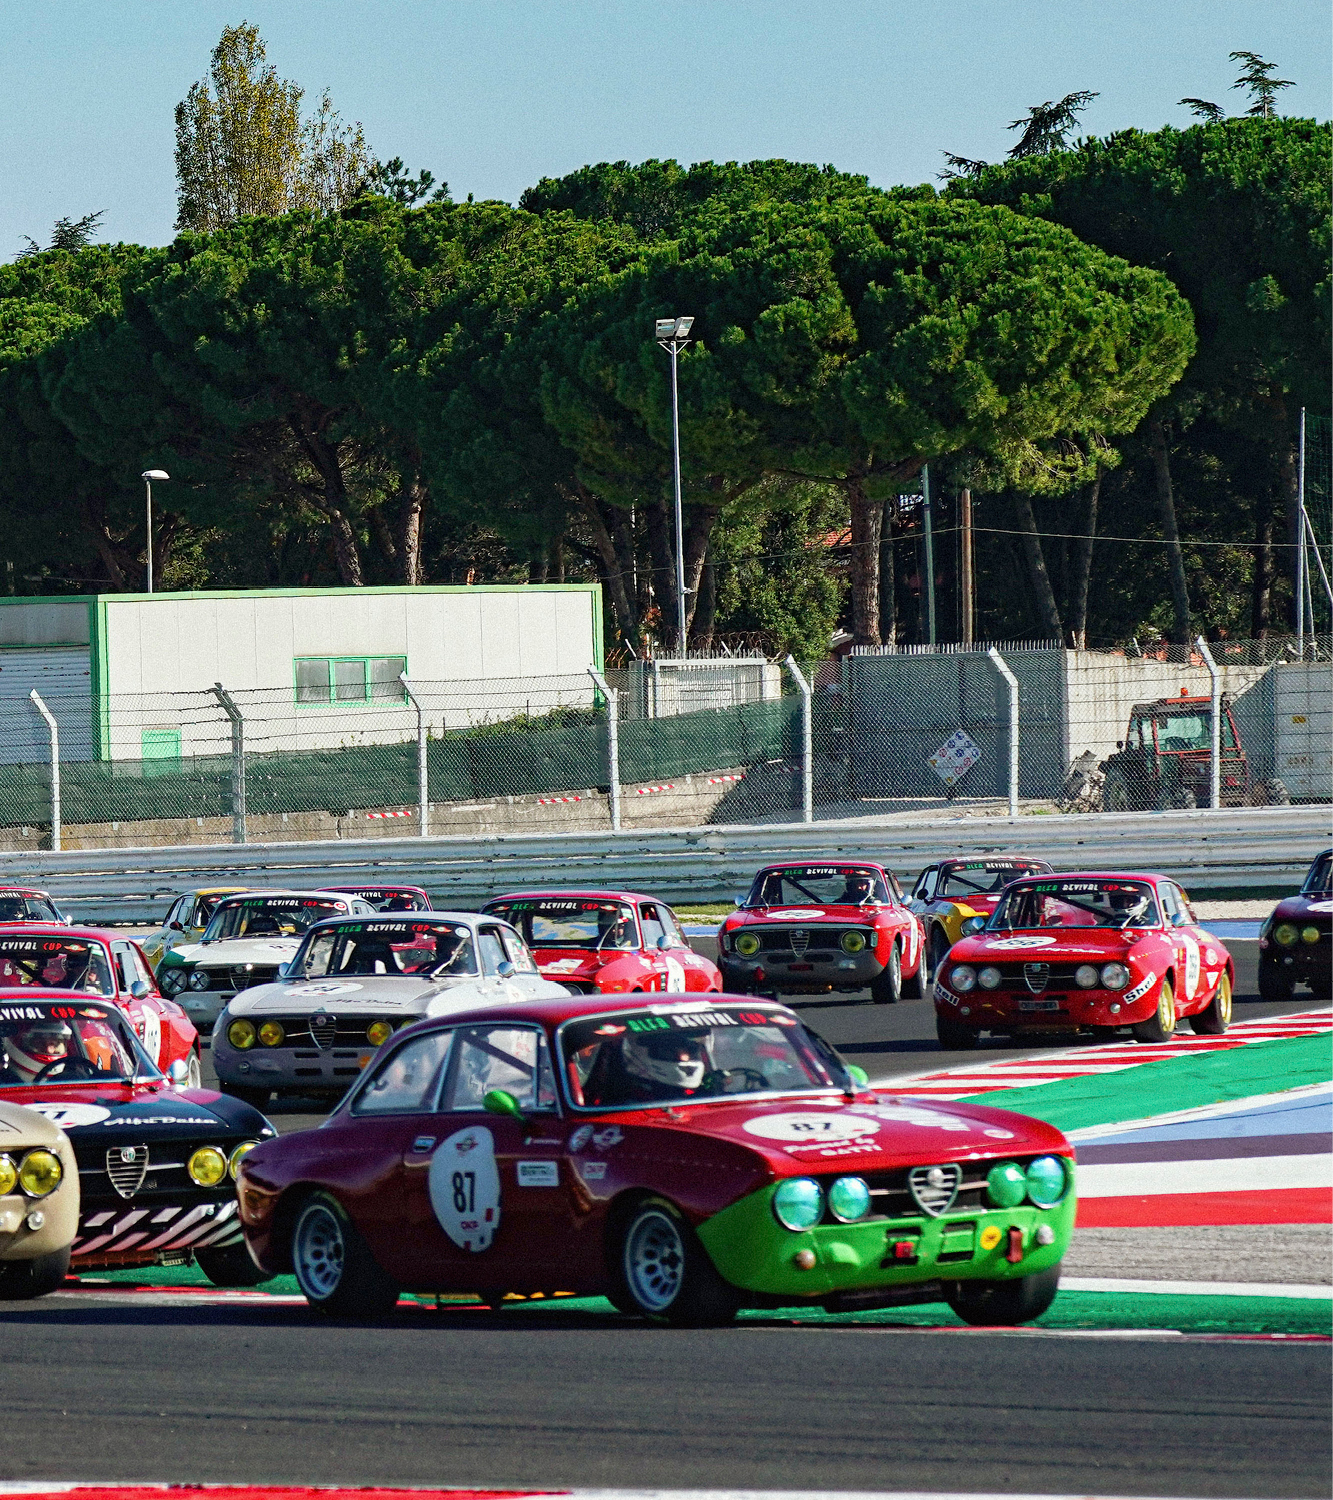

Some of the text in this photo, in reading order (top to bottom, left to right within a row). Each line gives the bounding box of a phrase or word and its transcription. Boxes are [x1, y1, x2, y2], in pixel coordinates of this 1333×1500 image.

[512, 903, 534, 911] ALF
[337, 925, 362, 933] ALFA
[366, 923, 407, 931] REVIVAL
[42, 942, 63, 950] CUP
[51, 1007, 77, 1019] CUP
[627, 1012, 767, 1033] ALFA REVIVAL CUP
[103, 1116, 218, 1126] Alfa Delta
[791, 1122, 833, 1131] 87
[452, 1171, 475, 1213] 87
